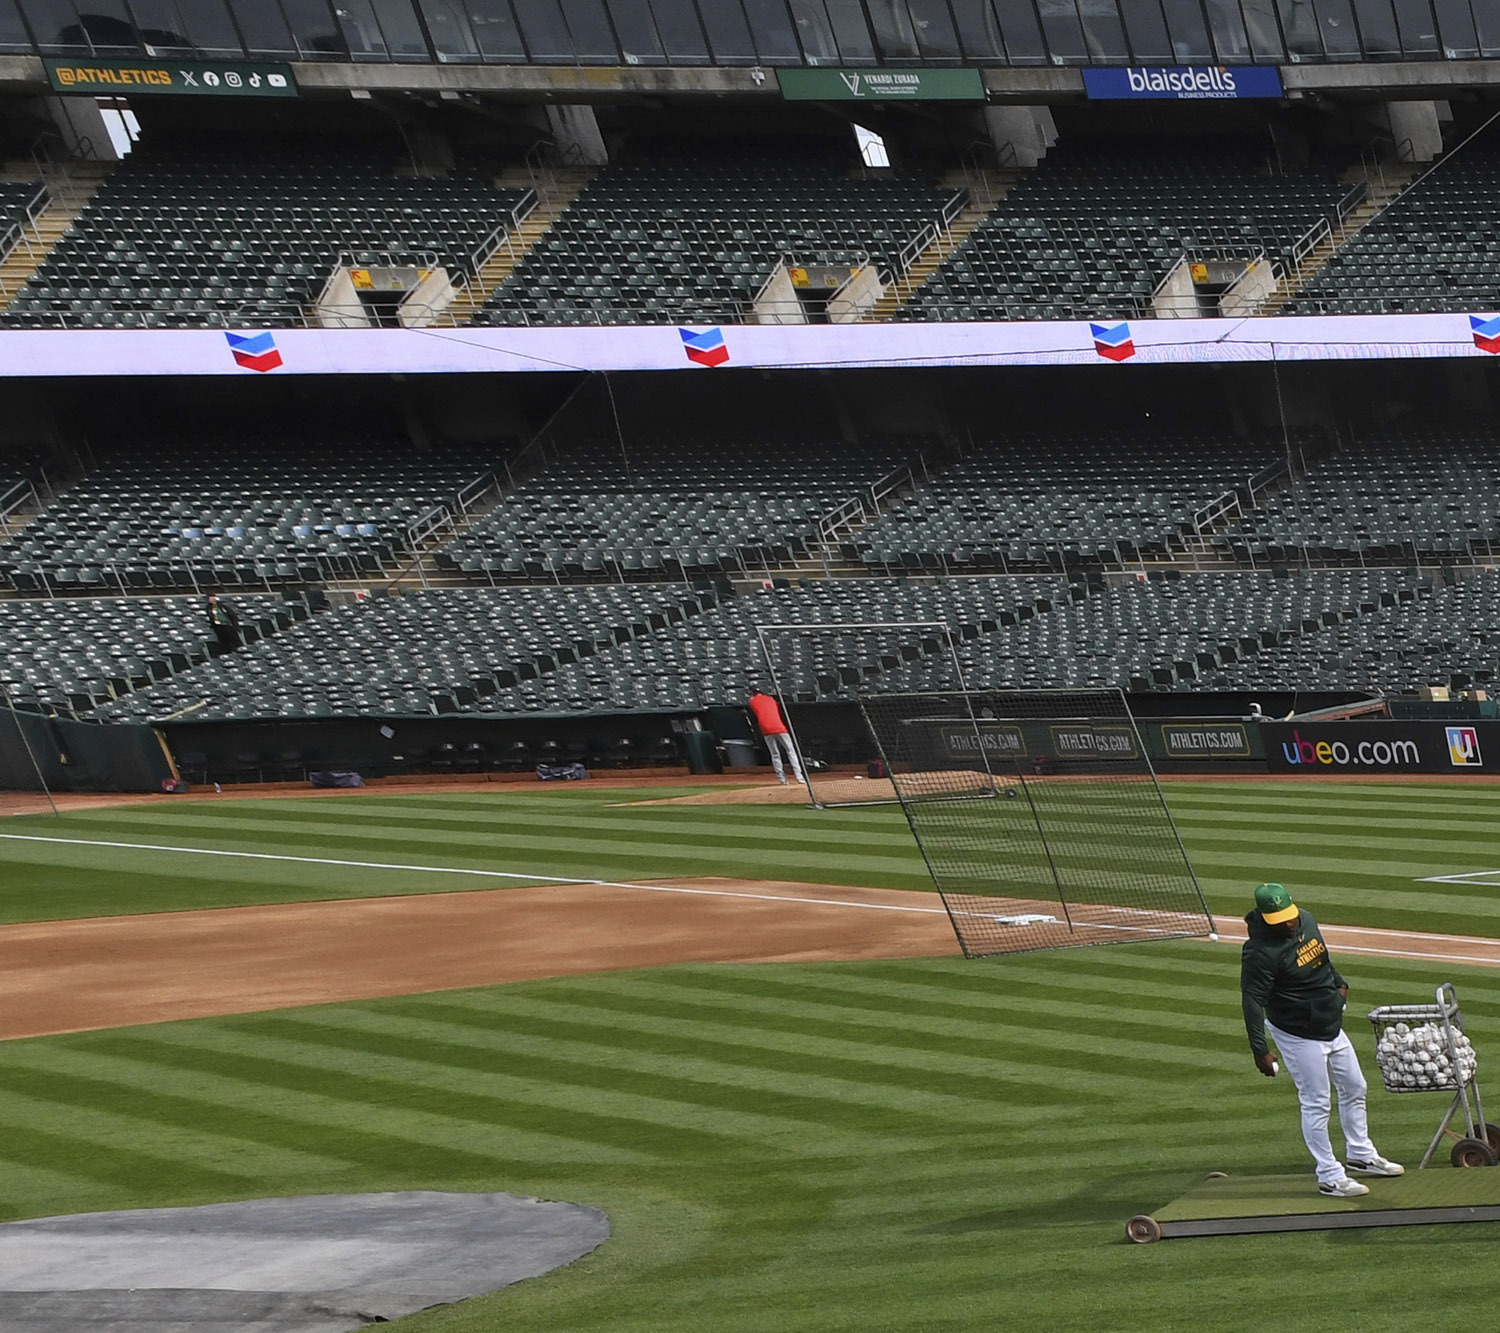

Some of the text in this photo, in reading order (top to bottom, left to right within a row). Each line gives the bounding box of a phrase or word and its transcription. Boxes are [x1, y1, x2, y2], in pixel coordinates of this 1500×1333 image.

[56, 67, 172, 86] @ATHLETICS
[1169, 732, 1243, 749] ATHLETICS.COM
[1281, 730, 1420, 764] ubeo.com
